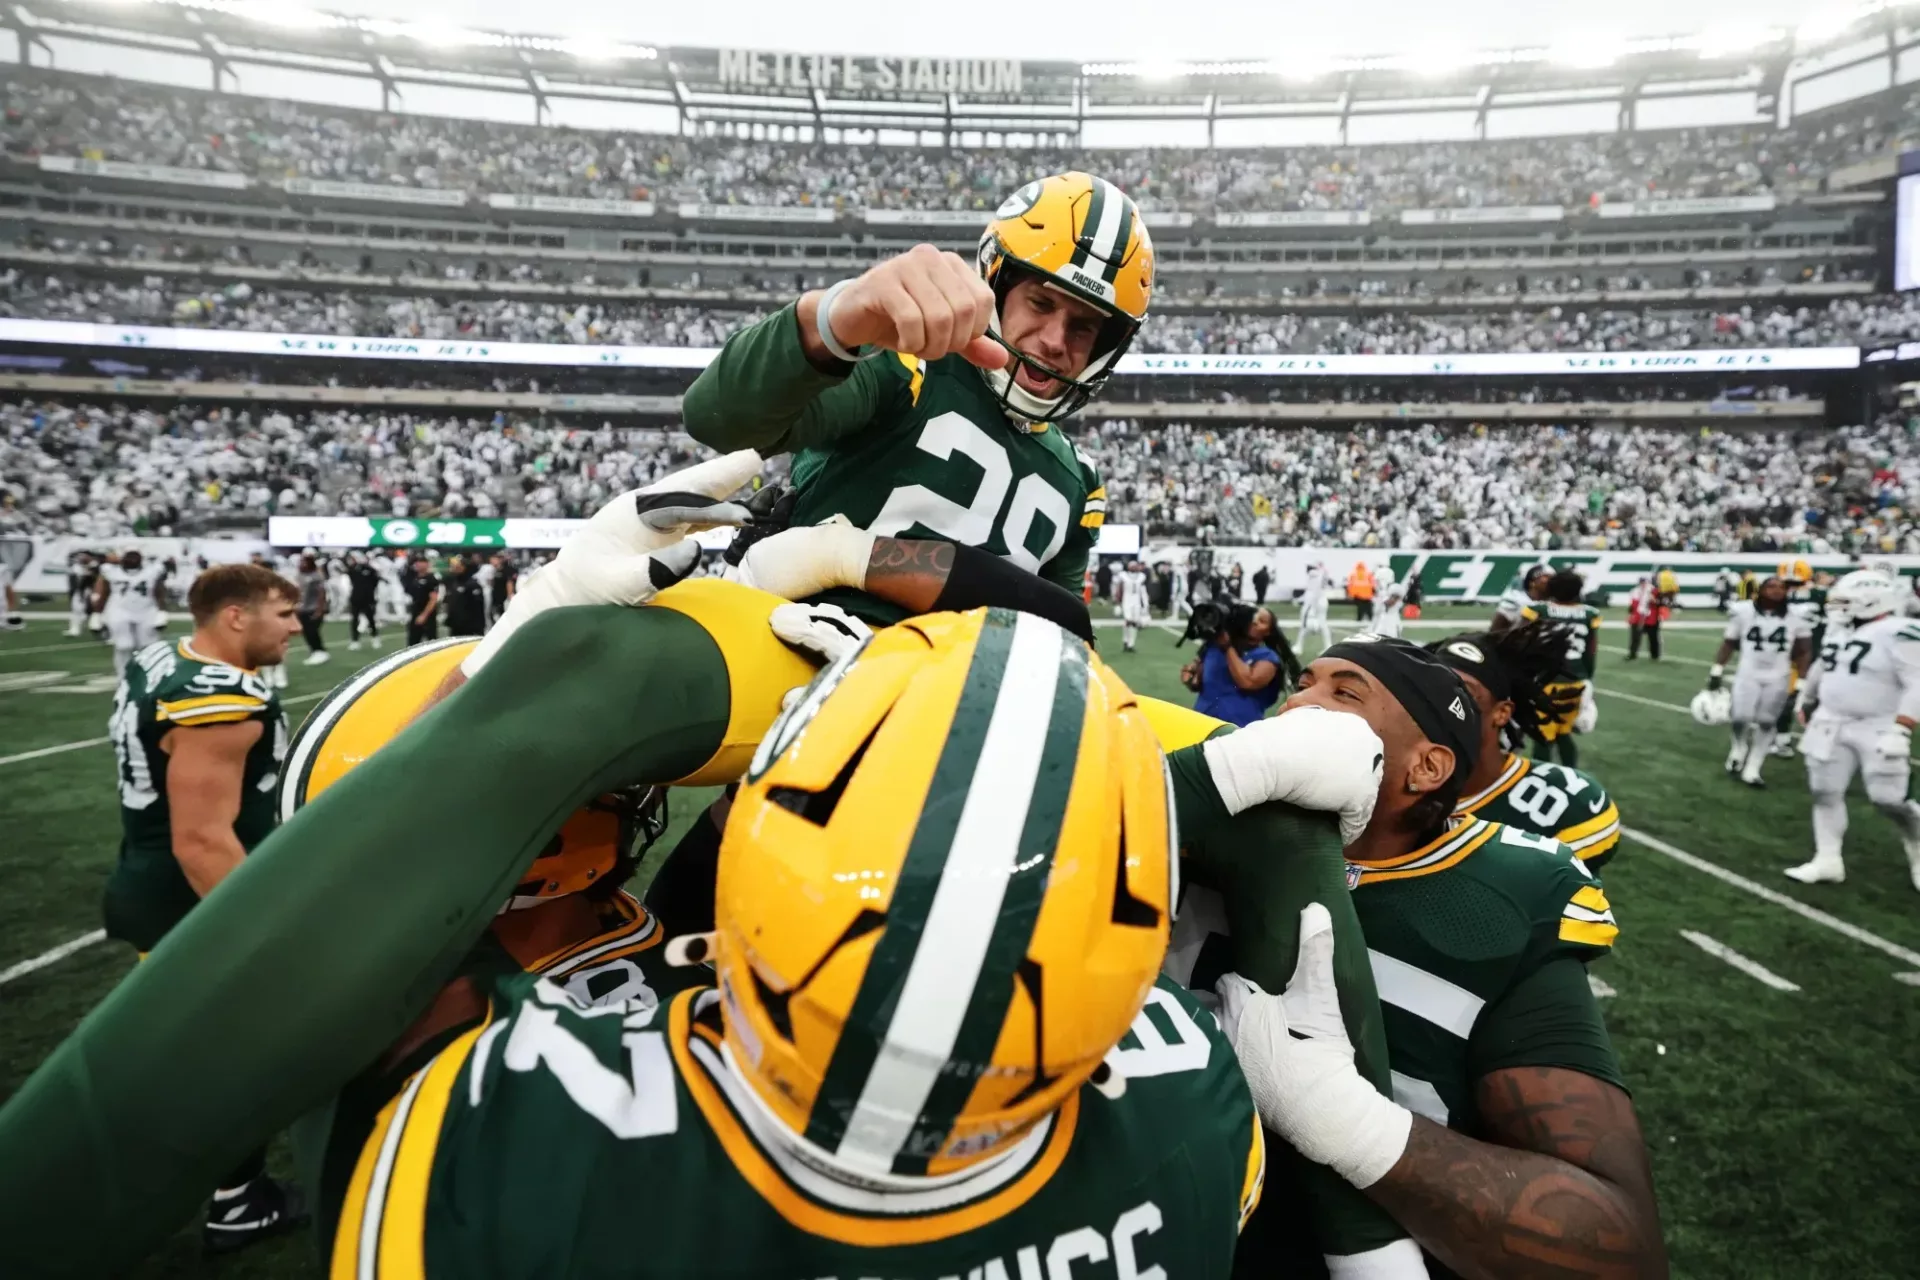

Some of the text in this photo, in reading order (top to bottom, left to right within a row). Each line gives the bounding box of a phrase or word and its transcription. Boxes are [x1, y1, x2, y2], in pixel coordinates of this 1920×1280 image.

[718, 50, 1022, 93] METLIFE STADIUM
[1071, 270, 1106, 297] PACKERS
[866, 411, 1070, 575] 28
[112, 581, 148, 597] 74
[1746, 625, 1788, 652] 44
[1507, 762, 1590, 828] 87
